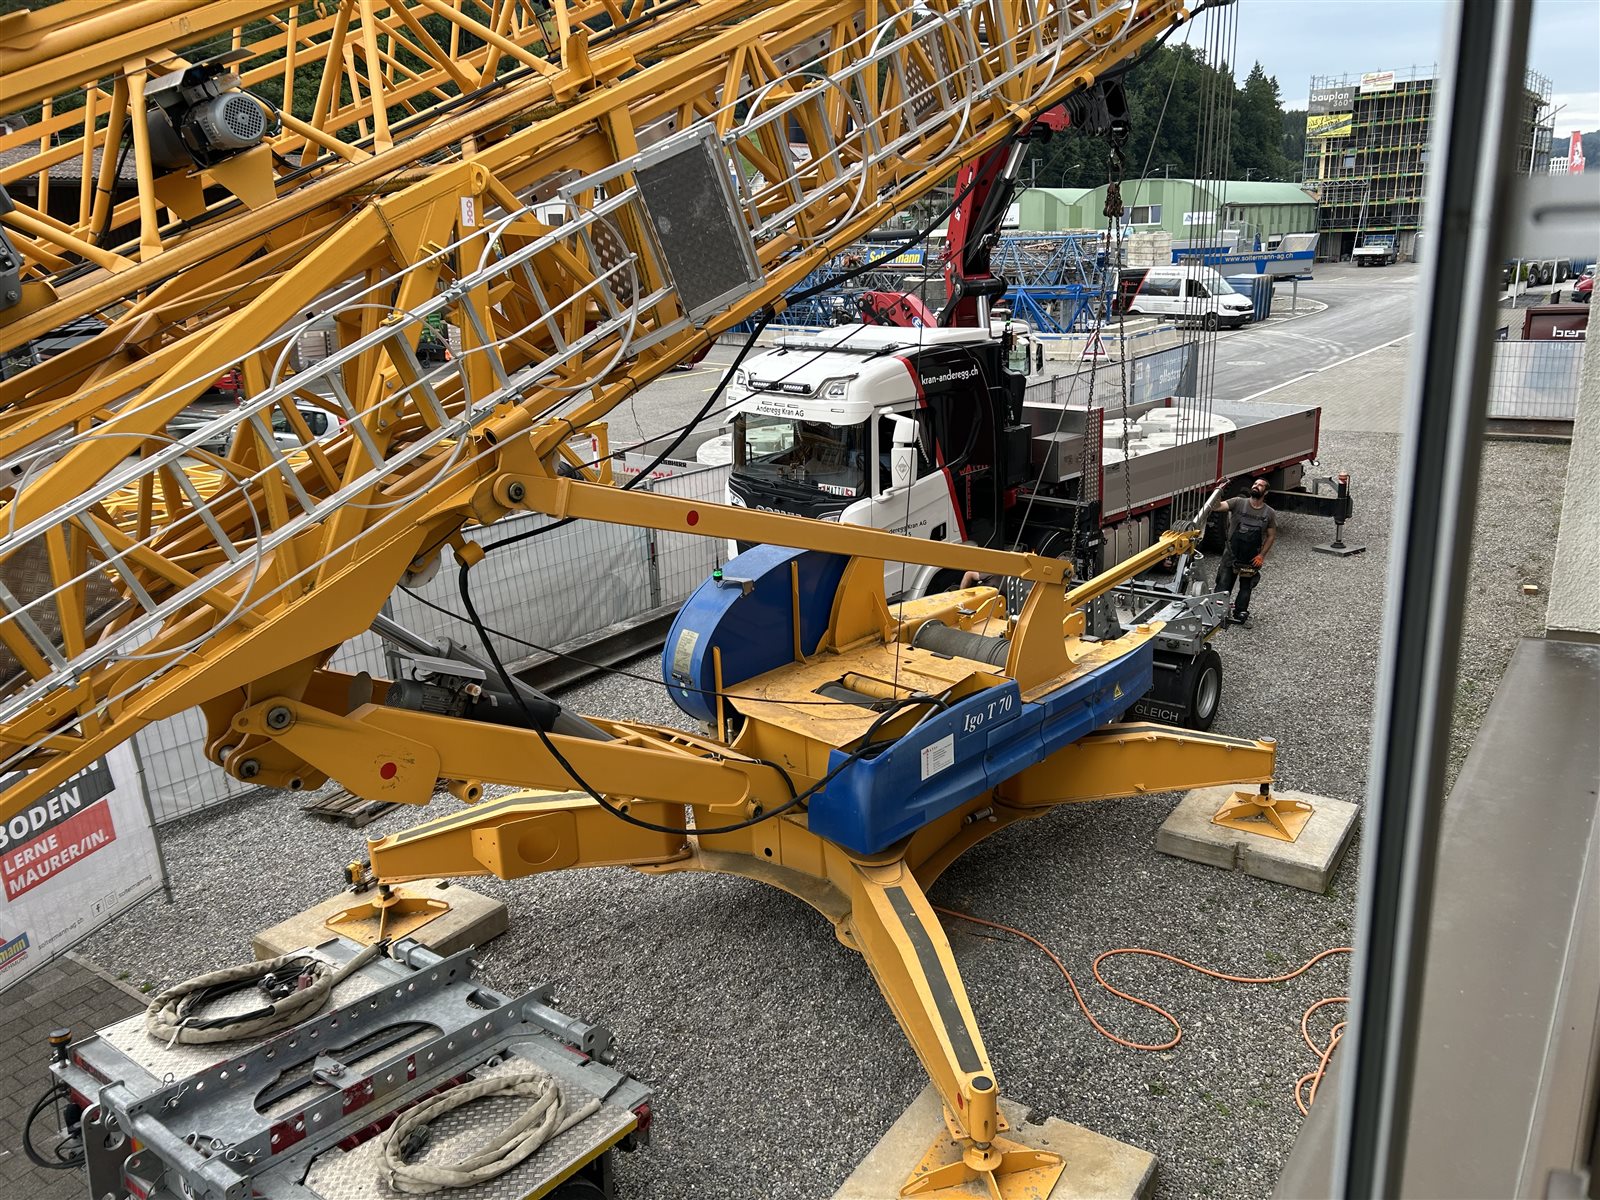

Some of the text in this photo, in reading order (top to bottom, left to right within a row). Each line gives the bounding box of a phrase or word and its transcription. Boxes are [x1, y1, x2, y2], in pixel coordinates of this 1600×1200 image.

[1311, 91, 1349, 102] bauplan
[1225, 252, 1294, 262] www.soltermann-ag.ch
[921, 365, 979, 385] kran-anderegg.ch
[756, 405, 805, 417] Anderegg Kran AG
[919, 519, 927, 527] AG
[963, 694, 1012, 733] Igo T 70
[1134, 704, 1179, 722] GLEICH
[0, 786, 81, 849] BODEN
[3, 833, 59, 875] LERNE
[8, 829, 110, 895] MAURER/IN.
